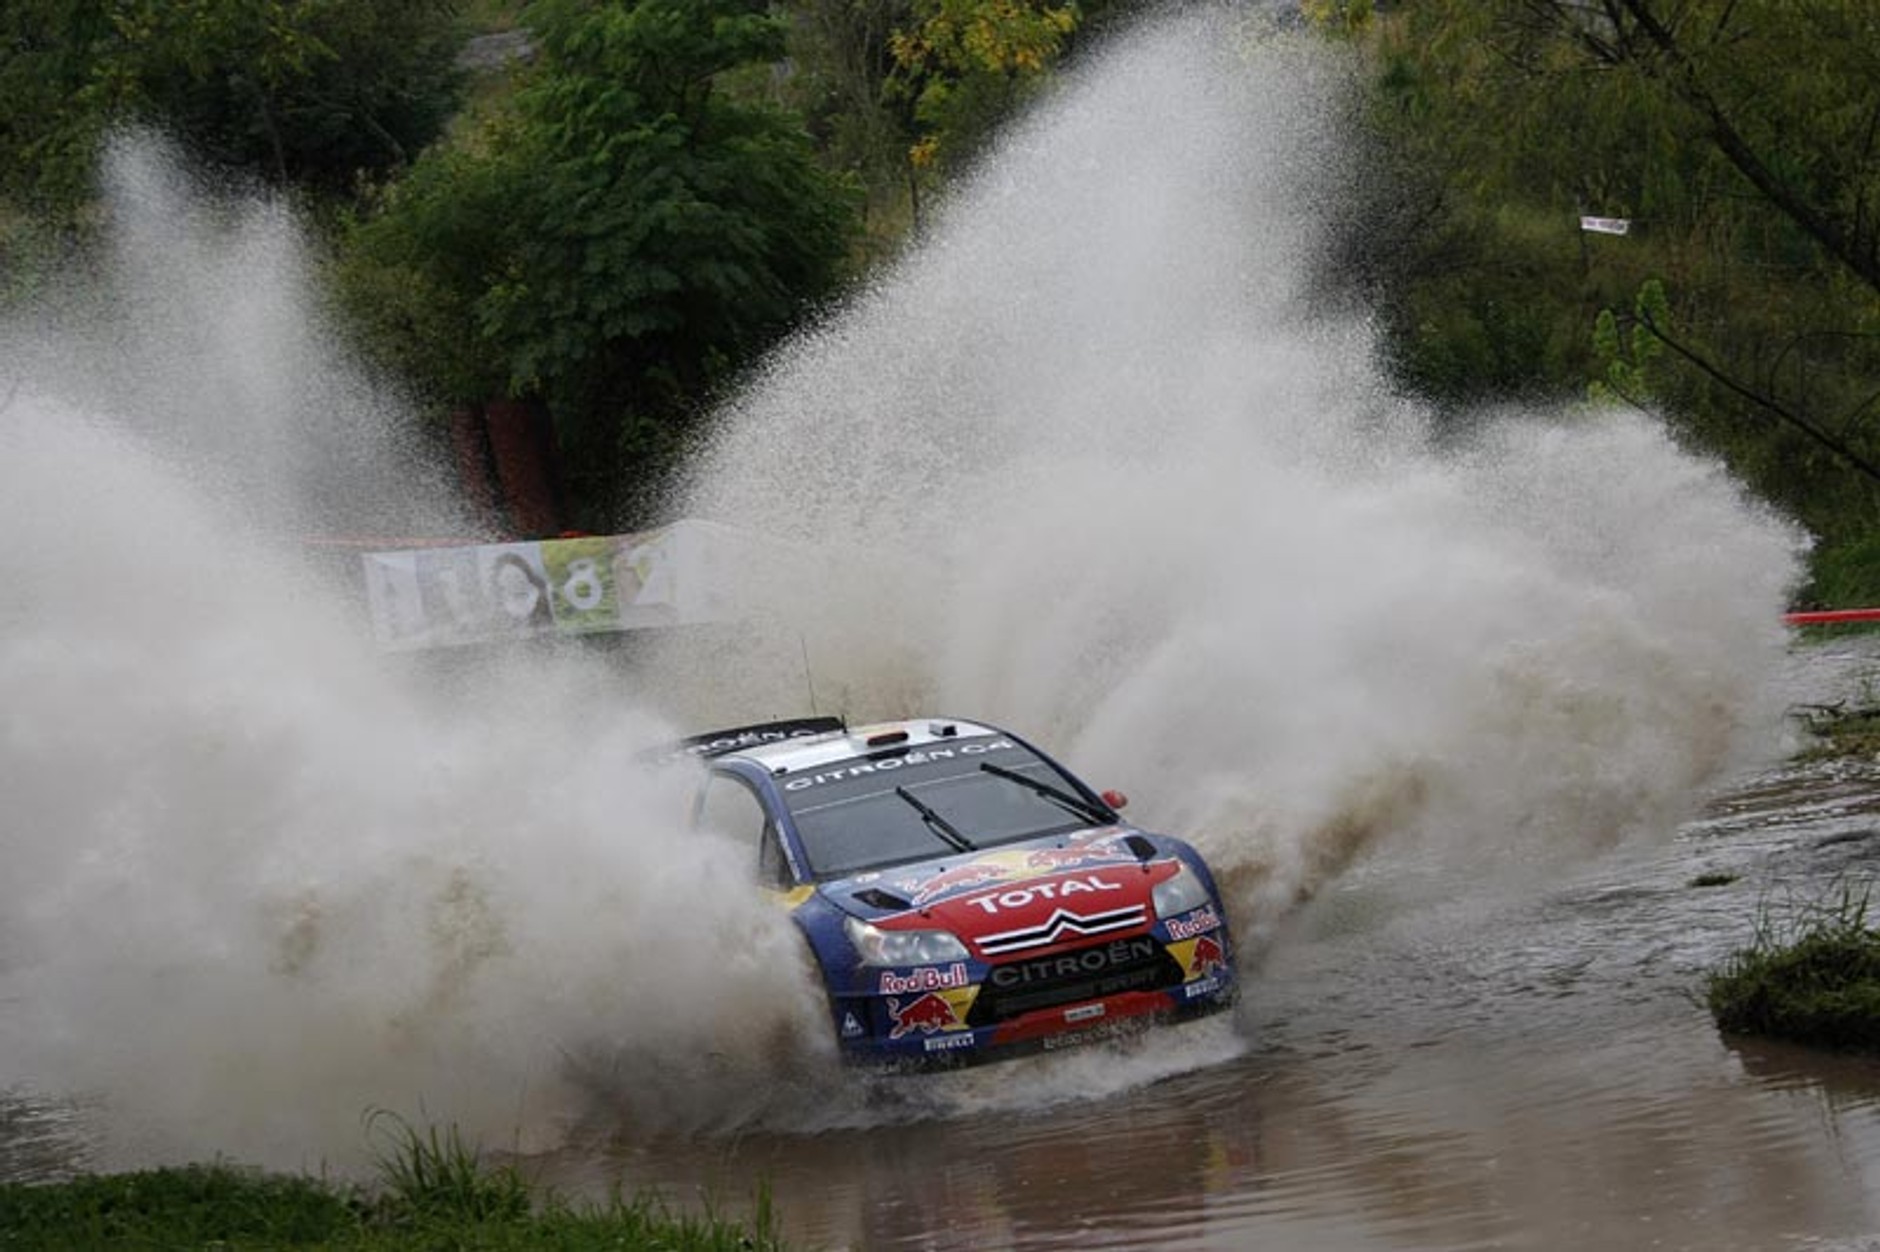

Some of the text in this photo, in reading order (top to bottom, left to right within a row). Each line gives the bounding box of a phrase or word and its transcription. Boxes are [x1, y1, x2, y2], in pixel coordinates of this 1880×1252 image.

[785, 748, 955, 791] CITROËN
[966, 876, 1121, 914] TOTAL
[879, 963, 968, 994] Red Bull
[992, 940, 1154, 986] CITROËN
[924, 1033, 974, 1051] PIRELLI
